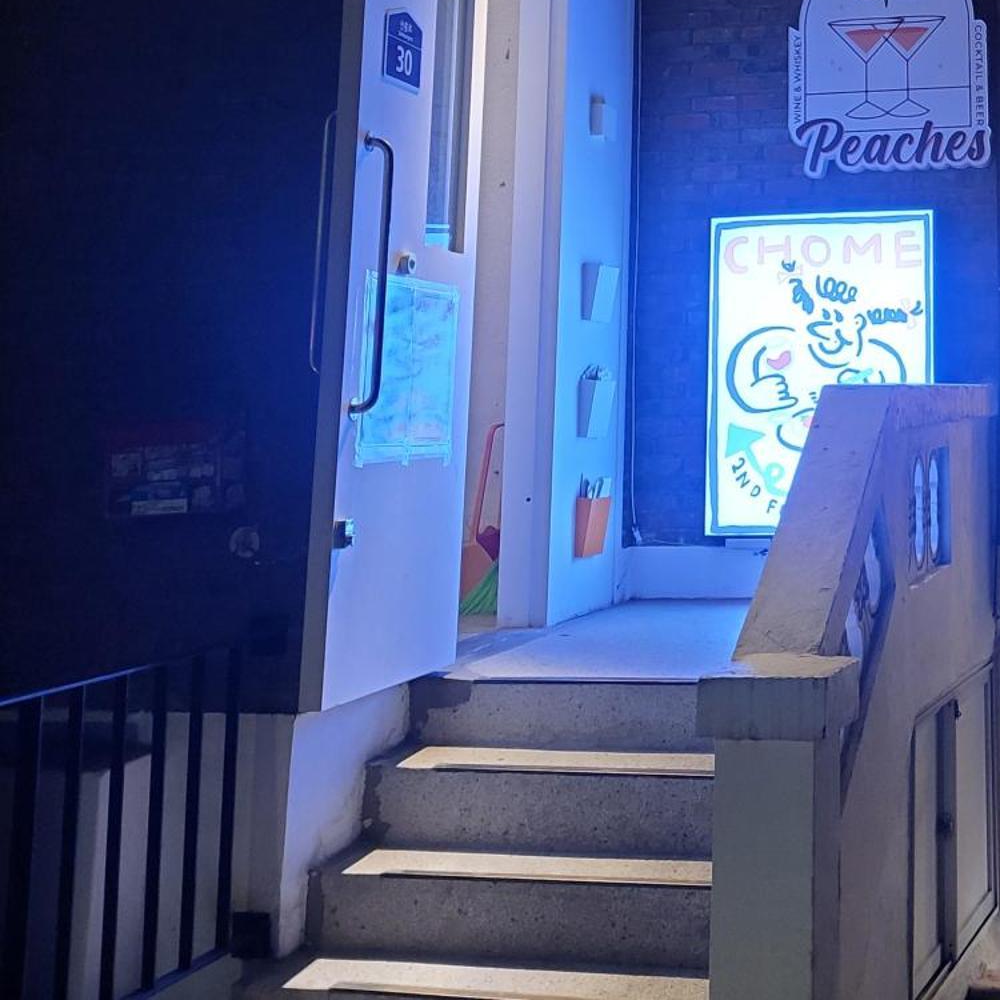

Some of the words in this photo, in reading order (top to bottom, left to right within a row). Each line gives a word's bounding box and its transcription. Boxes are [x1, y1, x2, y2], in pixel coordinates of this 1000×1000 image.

[396, 45, 412, 76] 30
[793, 35, 802, 84] WHISKEY
[975, 24, 984, 80] COCKTAIL
[793, 95, 802, 125] WINE
[976, 95, 985, 126] BEER
[796, 118, 985, 172] Peaches
[723, 230, 922, 274] CHOME
